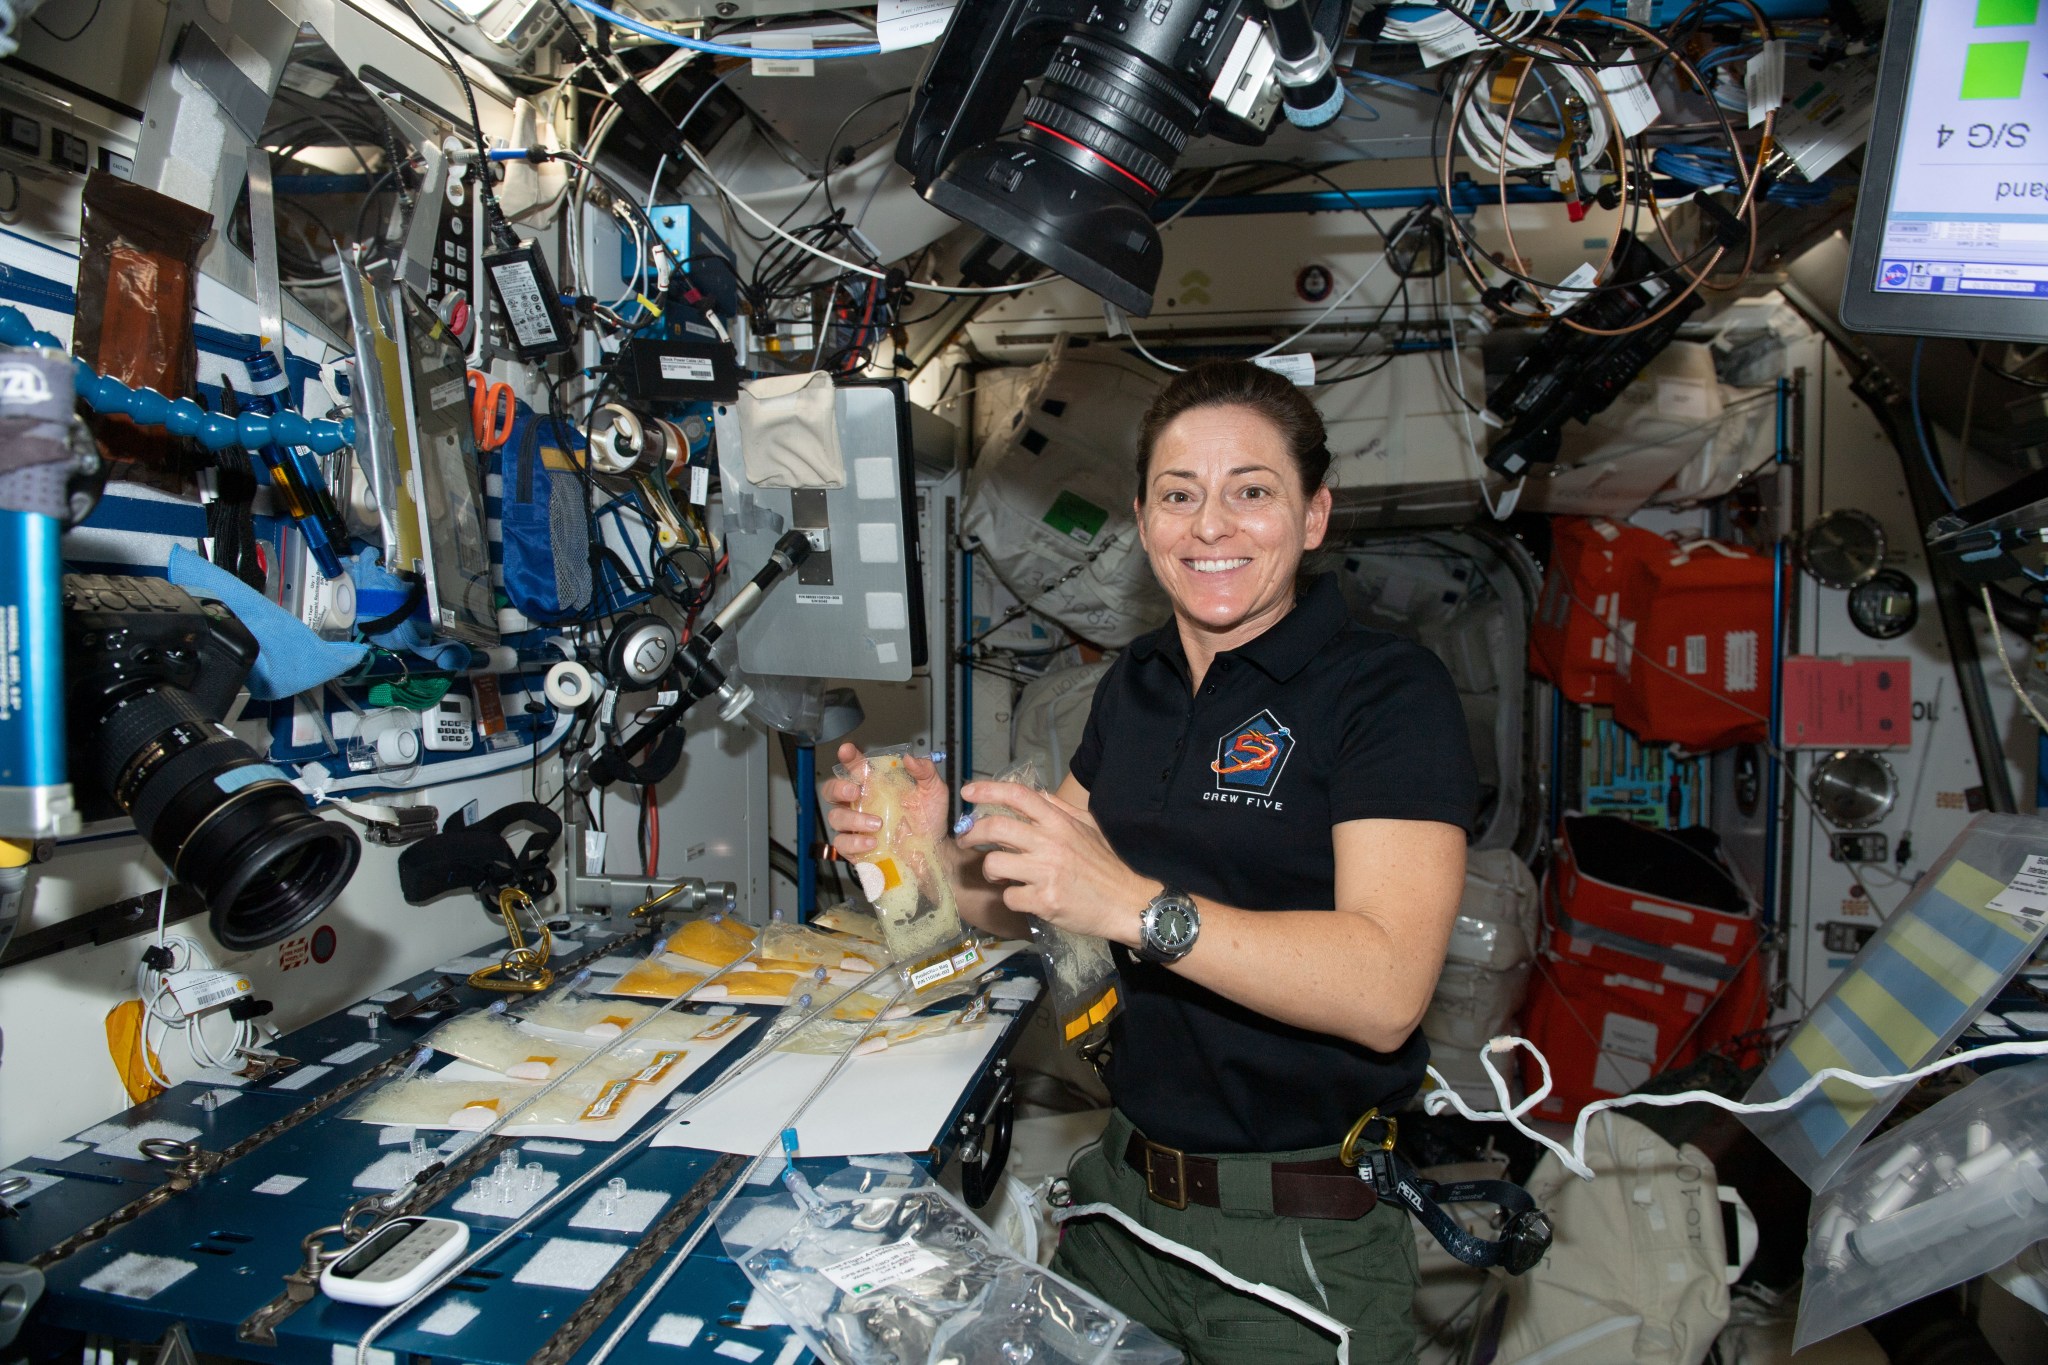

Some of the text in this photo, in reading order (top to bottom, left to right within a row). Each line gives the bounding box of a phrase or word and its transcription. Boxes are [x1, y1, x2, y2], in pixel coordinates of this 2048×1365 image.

[1937, 122, 2031, 149] S/G 4
[1996, 181, 2048, 201] and
[1203, 792, 1283, 811] CREW FIVE
[915, 967, 938, 980] Production
[1397, 1180, 1424, 1212] PETZL
[1442, 1226, 1482, 1257] TIKKA
